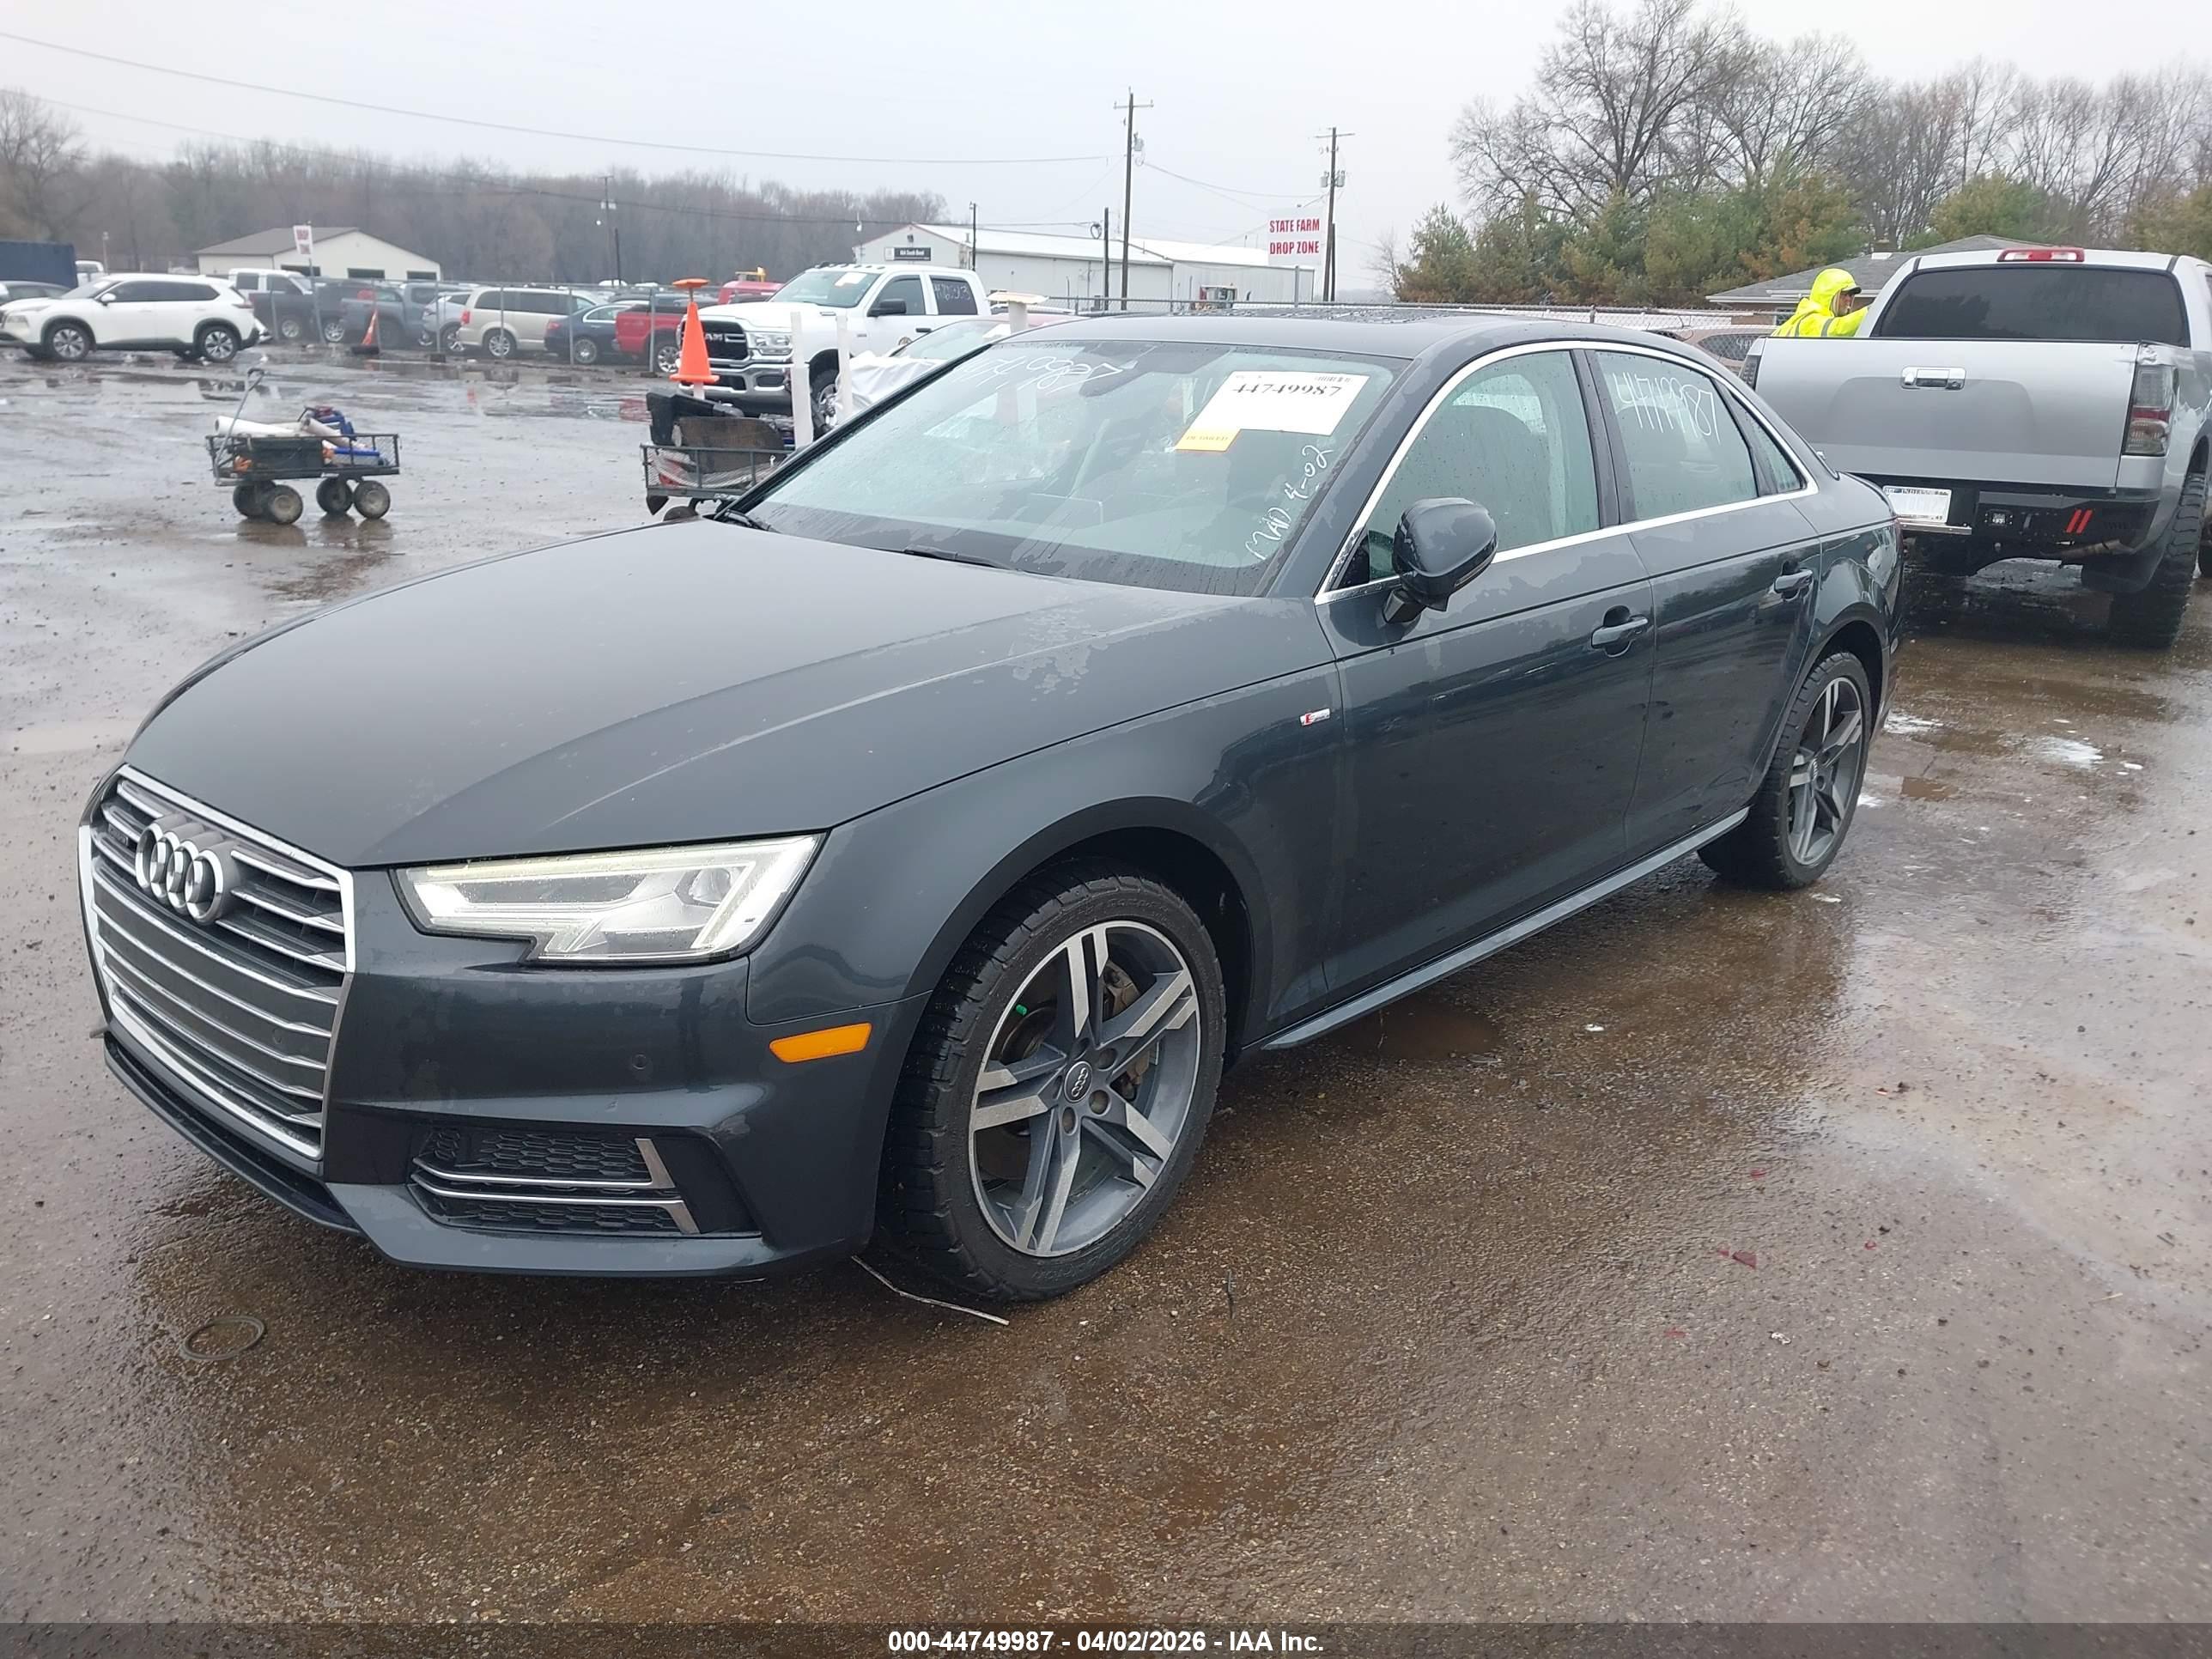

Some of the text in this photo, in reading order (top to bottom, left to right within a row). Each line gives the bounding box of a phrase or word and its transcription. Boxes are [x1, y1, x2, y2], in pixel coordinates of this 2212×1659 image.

[1269, 218, 1320, 233] STATE FARM
[1269, 240, 1320, 255] DROP ZONE
[1232, 383, 1342, 397] 44749987
